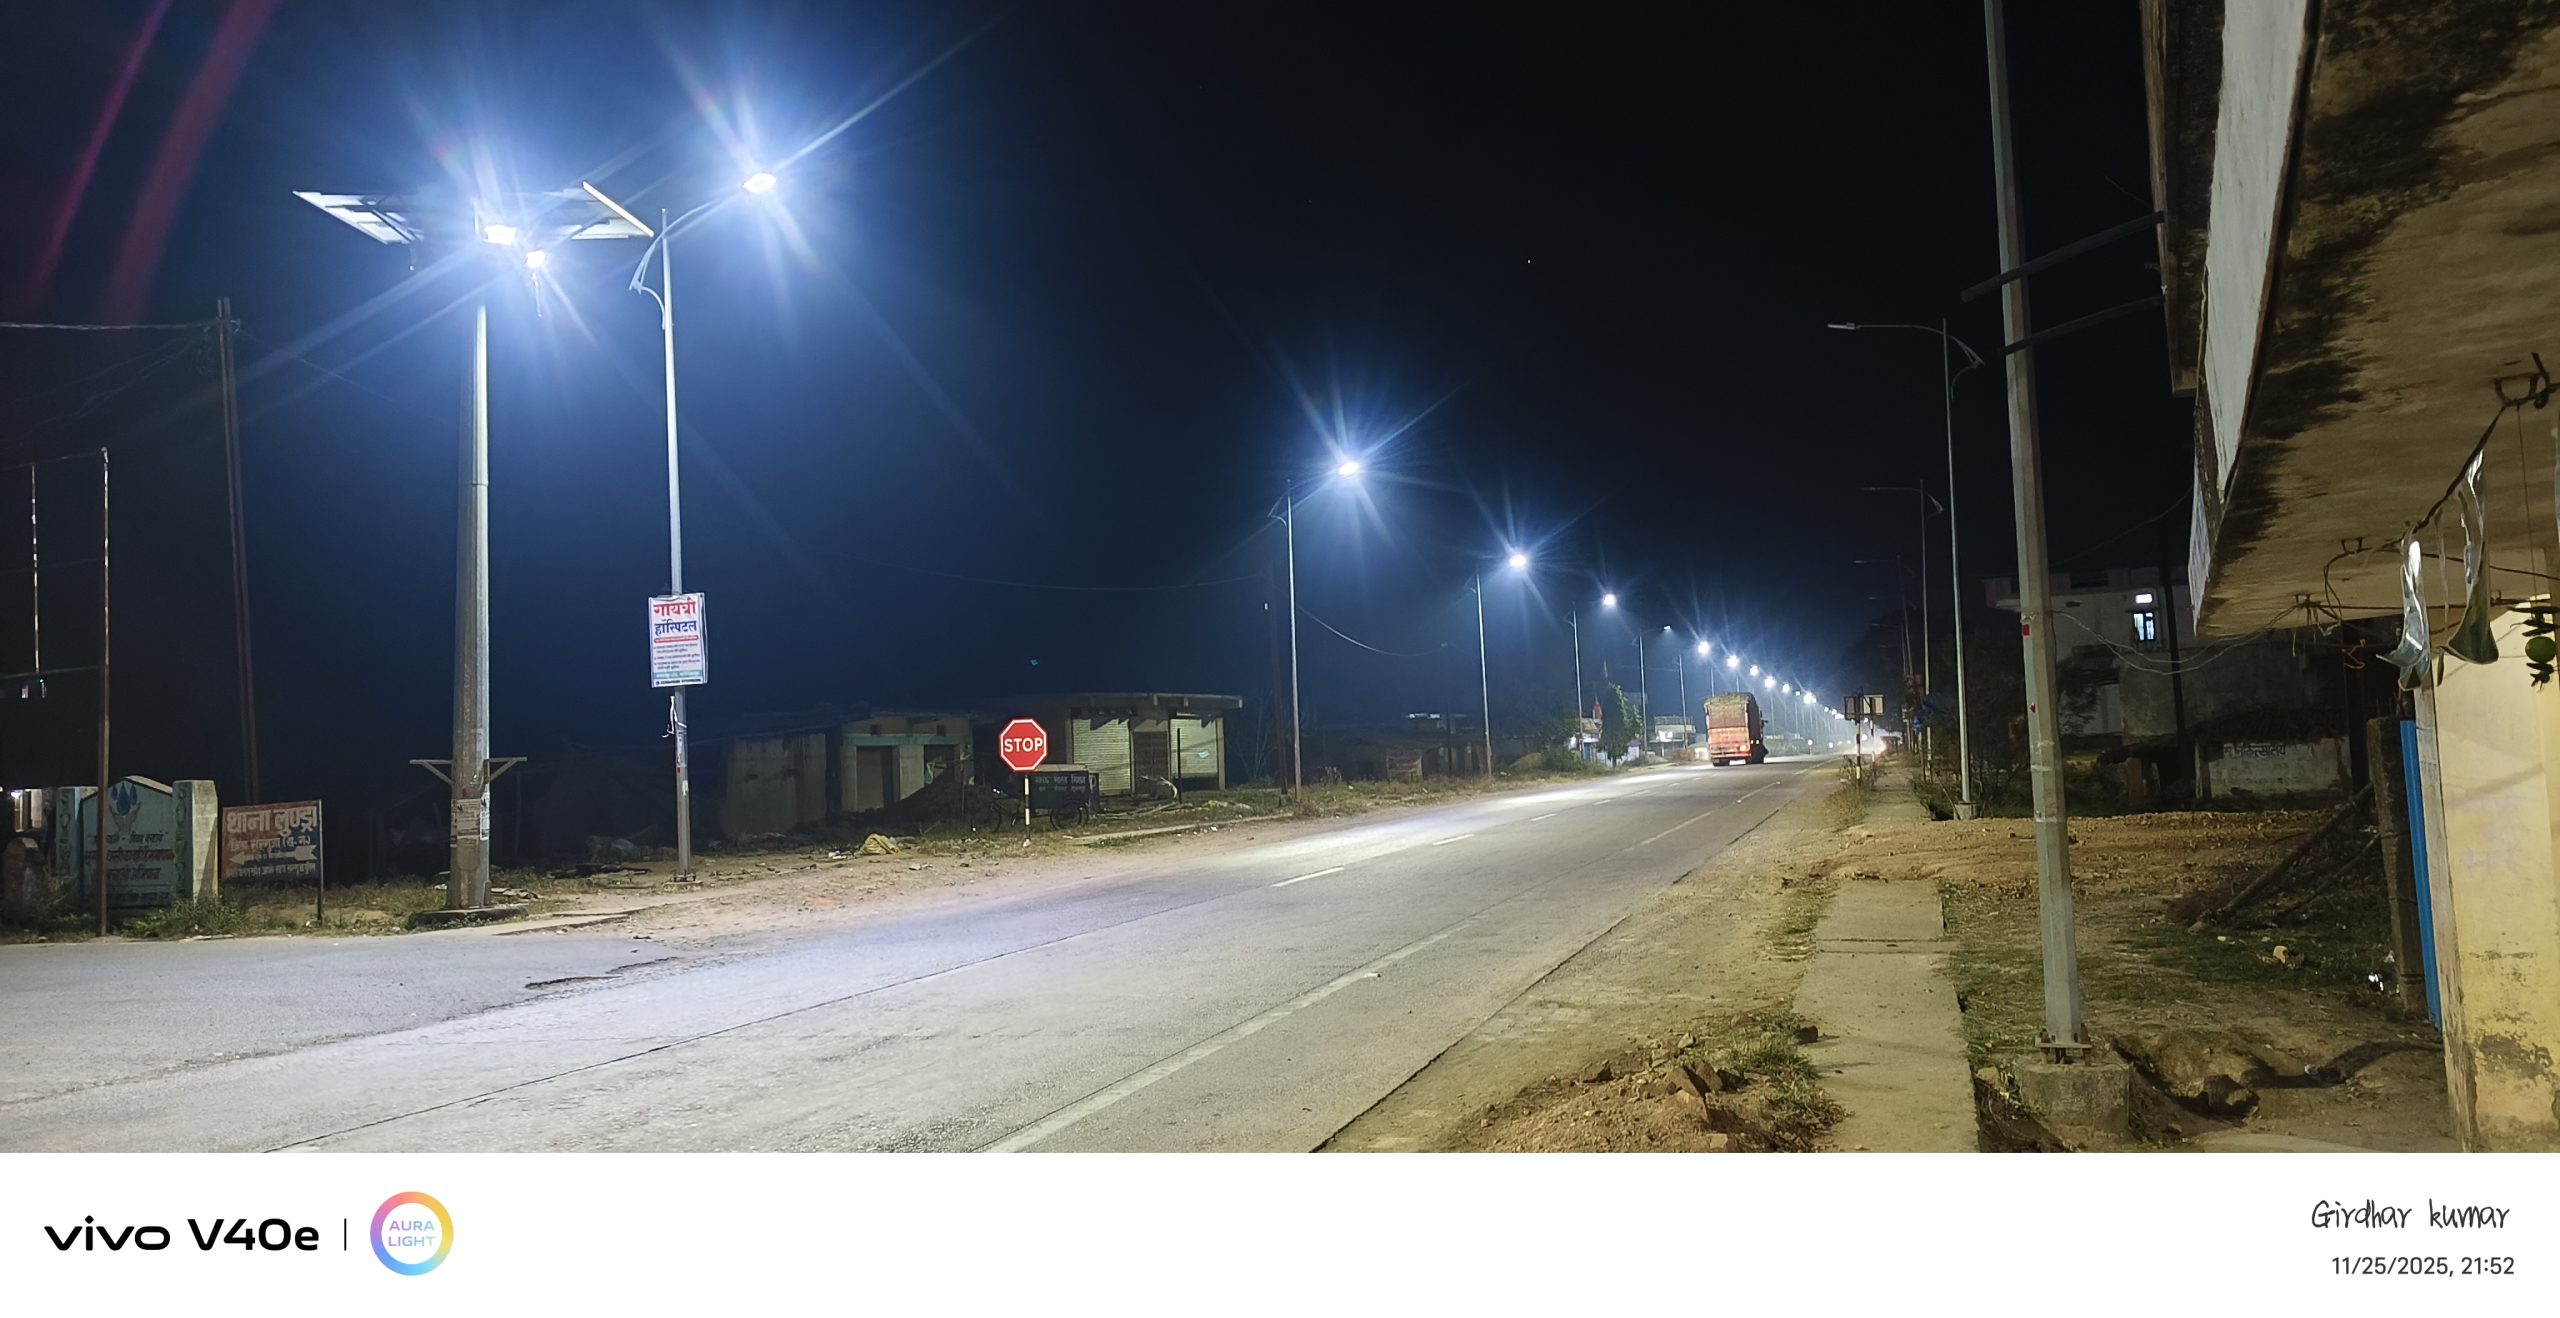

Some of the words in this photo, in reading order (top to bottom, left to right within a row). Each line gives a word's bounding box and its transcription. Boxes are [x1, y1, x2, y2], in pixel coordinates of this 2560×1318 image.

[653, 596, 696, 616] गायत्री
[654, 618, 697, 636] हॉस्पिटल
[1004, 737, 1043, 752] STOP
[227, 808, 271, 834] थाना
